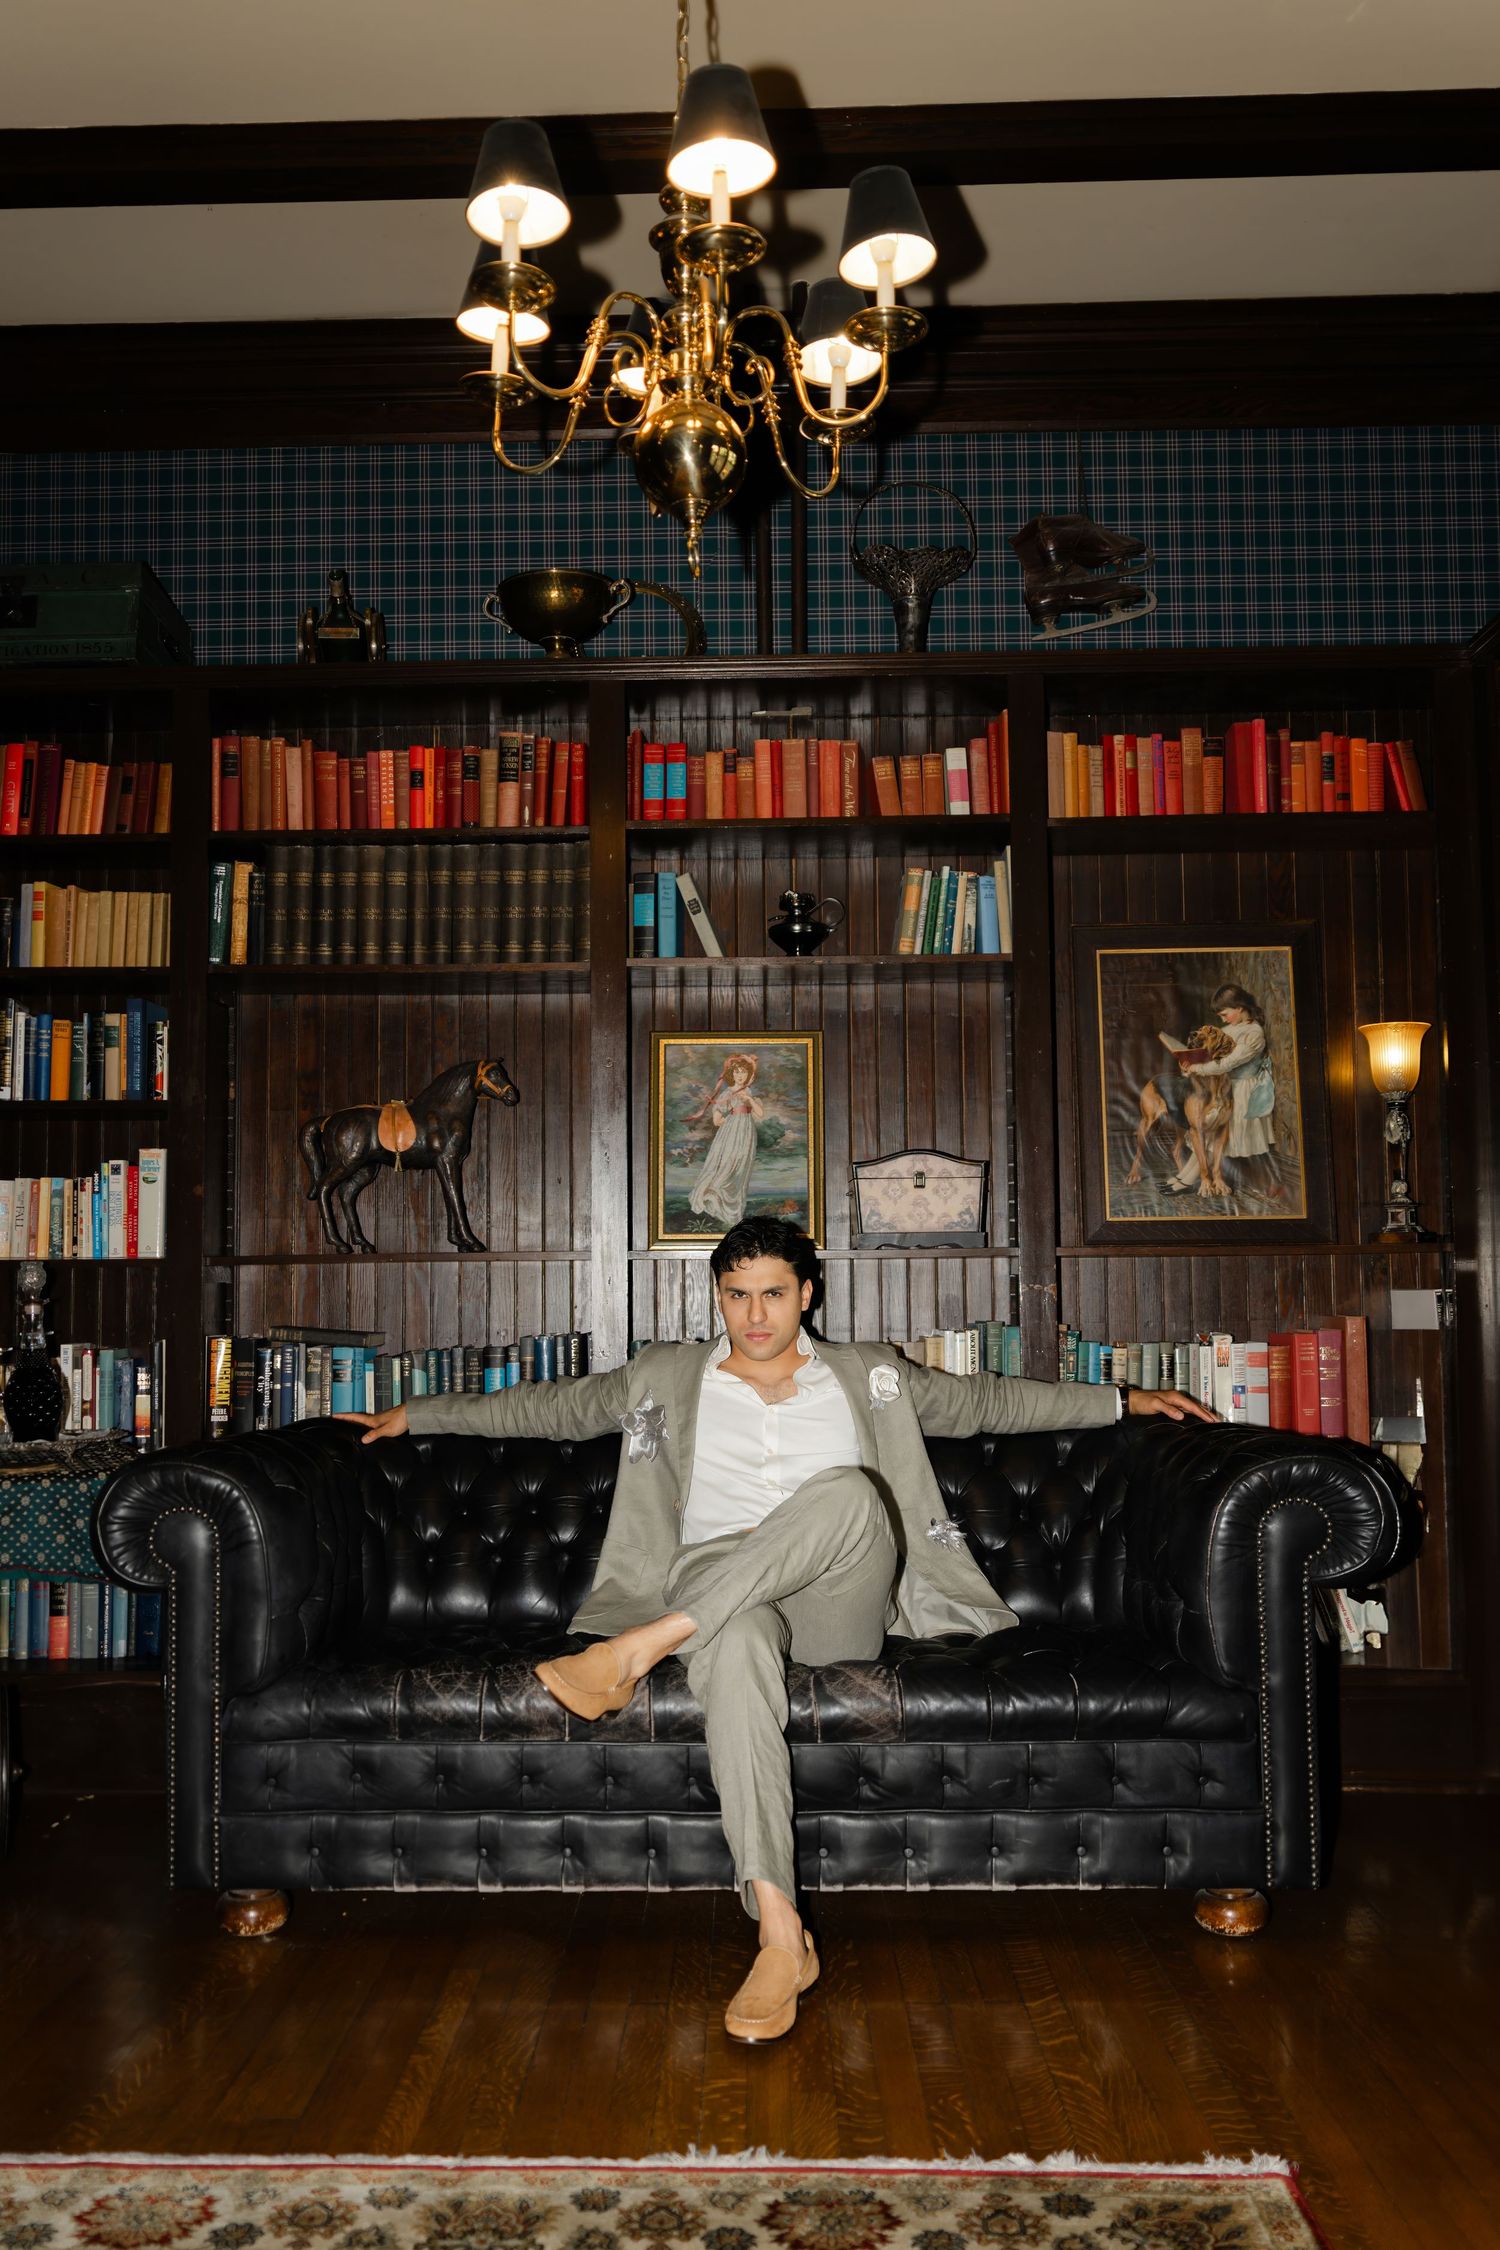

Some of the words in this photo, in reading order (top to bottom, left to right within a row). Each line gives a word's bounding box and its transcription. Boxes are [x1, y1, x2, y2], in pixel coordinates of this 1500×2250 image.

[381, 753, 387, 763] OF
[843, 751, 856, 772] Time
[844, 774, 853, 787] and
[844, 789, 853, 800] the
[15, 1206, 24, 1231] FALL
[216, 1338, 232, 1406] MANAGEMENT
[428, 1357, 437, 1379] HOME
[257, 1375, 265, 1393] City
[264, 1361, 273, 1409] Unheavenly
